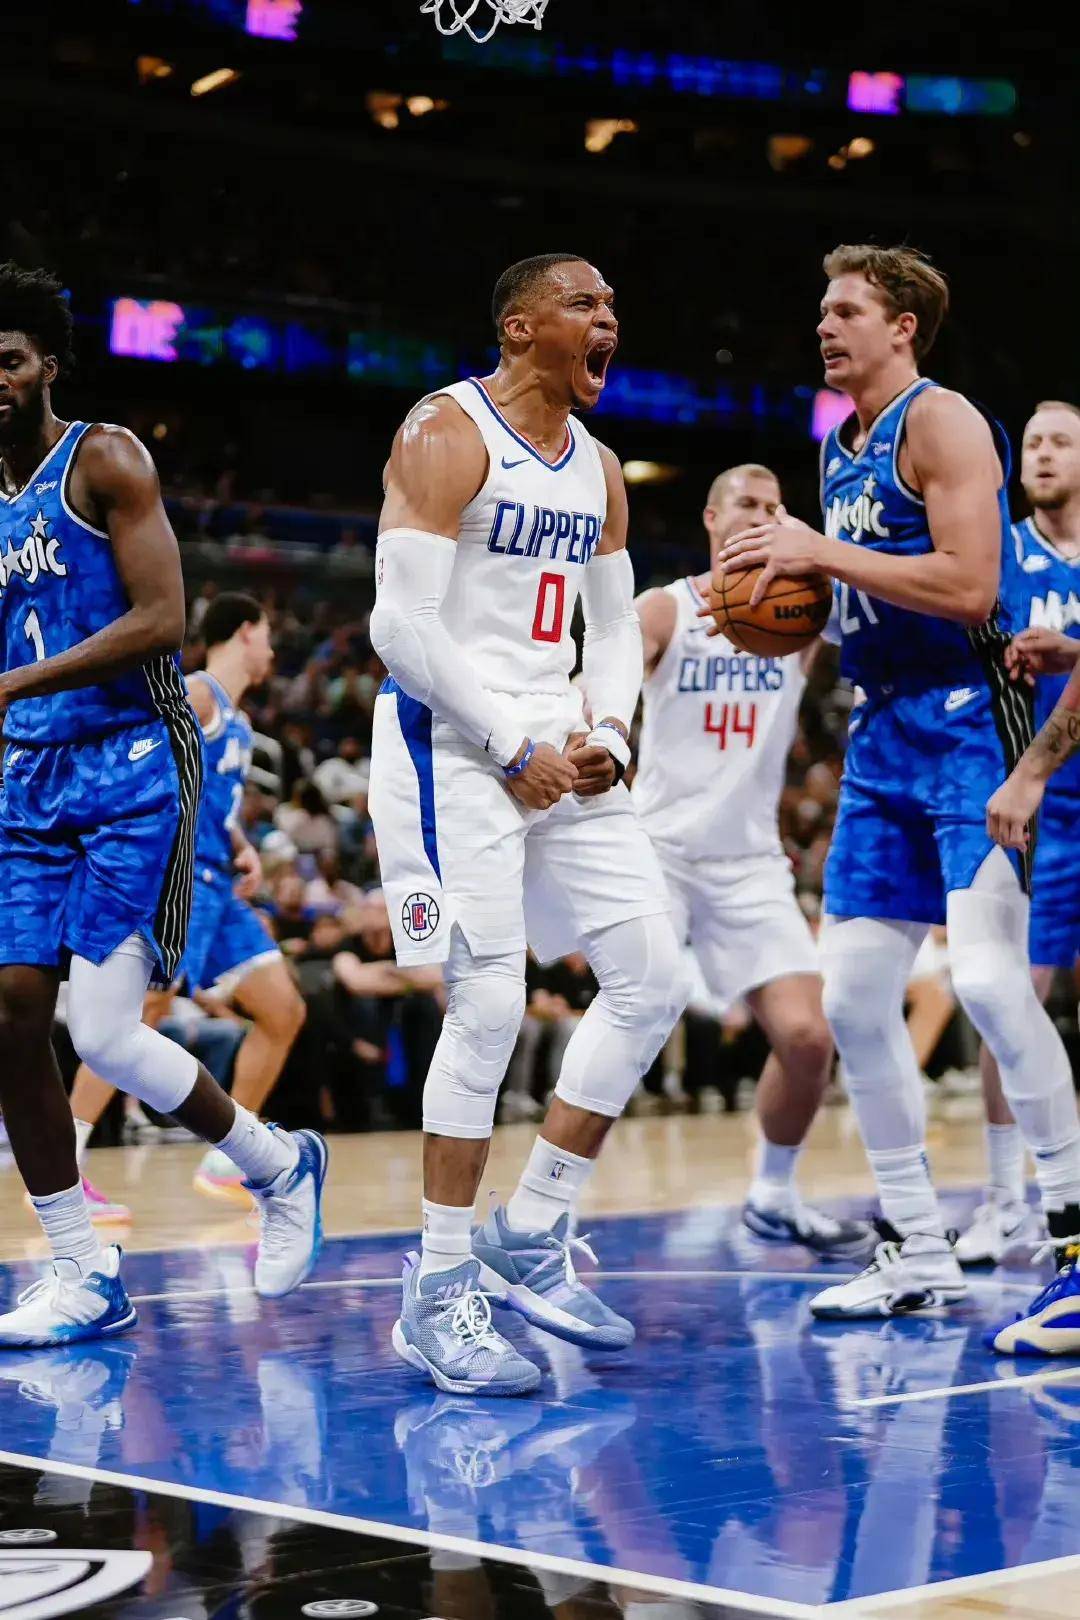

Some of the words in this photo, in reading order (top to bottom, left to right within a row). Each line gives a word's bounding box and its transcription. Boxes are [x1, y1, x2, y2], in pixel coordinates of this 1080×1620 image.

[531, 571, 566, 643] 0
[23, 607, 46, 662] 1
[677, 655, 784, 693] CLIPPERS
[703, 702, 757, 751] 44
